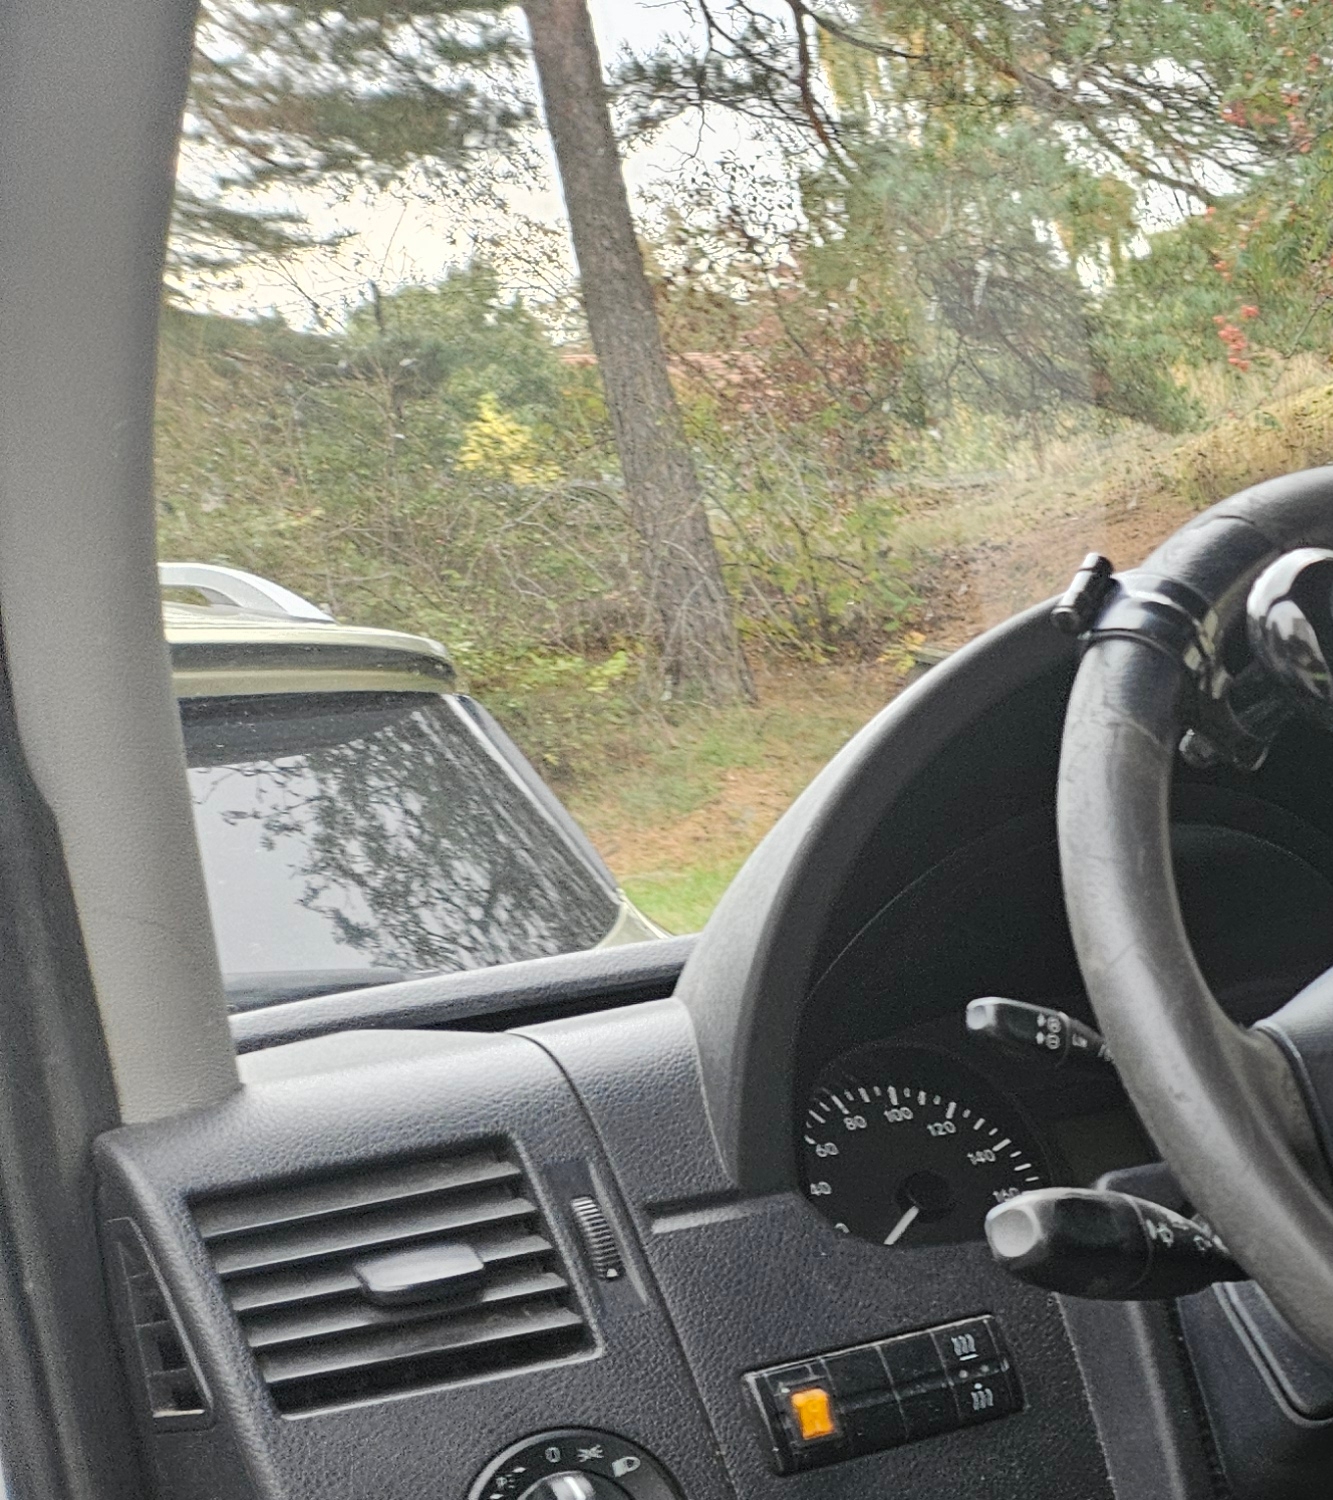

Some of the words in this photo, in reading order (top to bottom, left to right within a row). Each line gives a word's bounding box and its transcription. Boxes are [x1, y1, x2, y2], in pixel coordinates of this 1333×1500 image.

[884, 1106, 914, 1122] 100
[844, 1115, 867, 1130] 80
[927, 1121, 956, 1136] 120
[816, 1142, 839, 1157] 60
